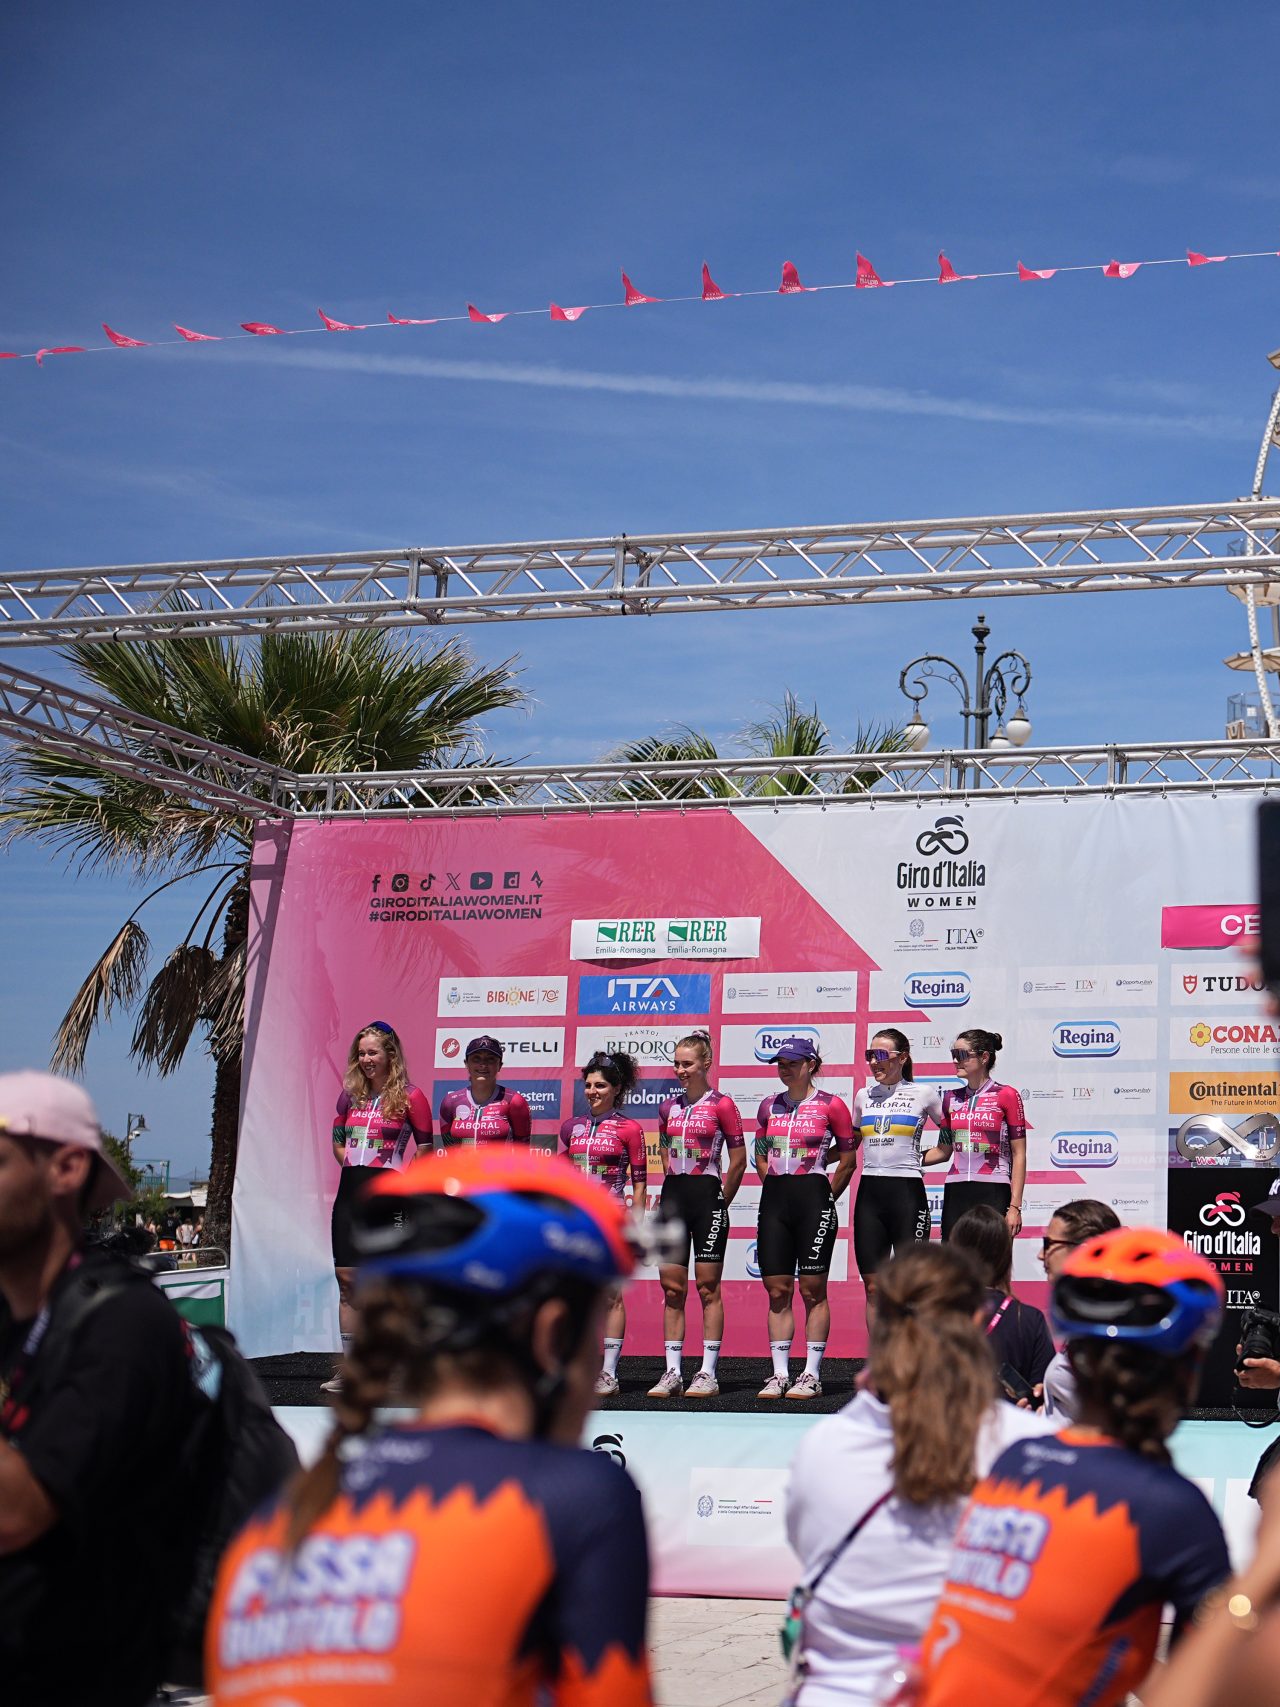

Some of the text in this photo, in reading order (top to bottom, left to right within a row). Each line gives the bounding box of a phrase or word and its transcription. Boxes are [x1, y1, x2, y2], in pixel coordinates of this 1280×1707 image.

[897, 860, 985, 889] Giro d'Italia
[370, 894, 543, 908] GIRODITALIAWOMEN.IT
[907, 896, 976, 908] WOMEN
[369, 908, 542, 922] #GIRODITALIAWOMEN
[946, 928, 978, 944] ITA
[596, 946, 656, 955] Emilia-Romagna
[667, 945, 727, 955] Emilia-Romagna
[607, 977, 680, 998] ITA
[911, 979, 965, 997] Regina
[1203, 976, 1270, 992] TUDO
[611, 1001, 676, 1011] AIRWAYS
[1060, 1029, 1115, 1047] Regina
[500, 1041, 558, 1053] STELLI
[606, 1040, 677, 1055] REDORO
[1210, 1045, 1240, 1054] Persone
[1242, 1045, 1260, 1054] oltre
[1263, 1045, 1270, 1054] le
[1189, 1081, 1277, 1101] Continental
[770, 1120, 816, 1128] LABORAL
[950, 1113, 995, 1121] LABORAL
[571, 1138, 615, 1146] LABORAL
[1057, 1139, 1112, 1157] Regina
[703, 1209, 722, 1252] LABORAL
[808, 1208, 832, 1260] LABORAL
[1184, 1230, 1261, 1255] Giro d'Italia
[1209, 1262, 1253, 1272] OMEN
[1227, 1290, 1254, 1304] ITA
